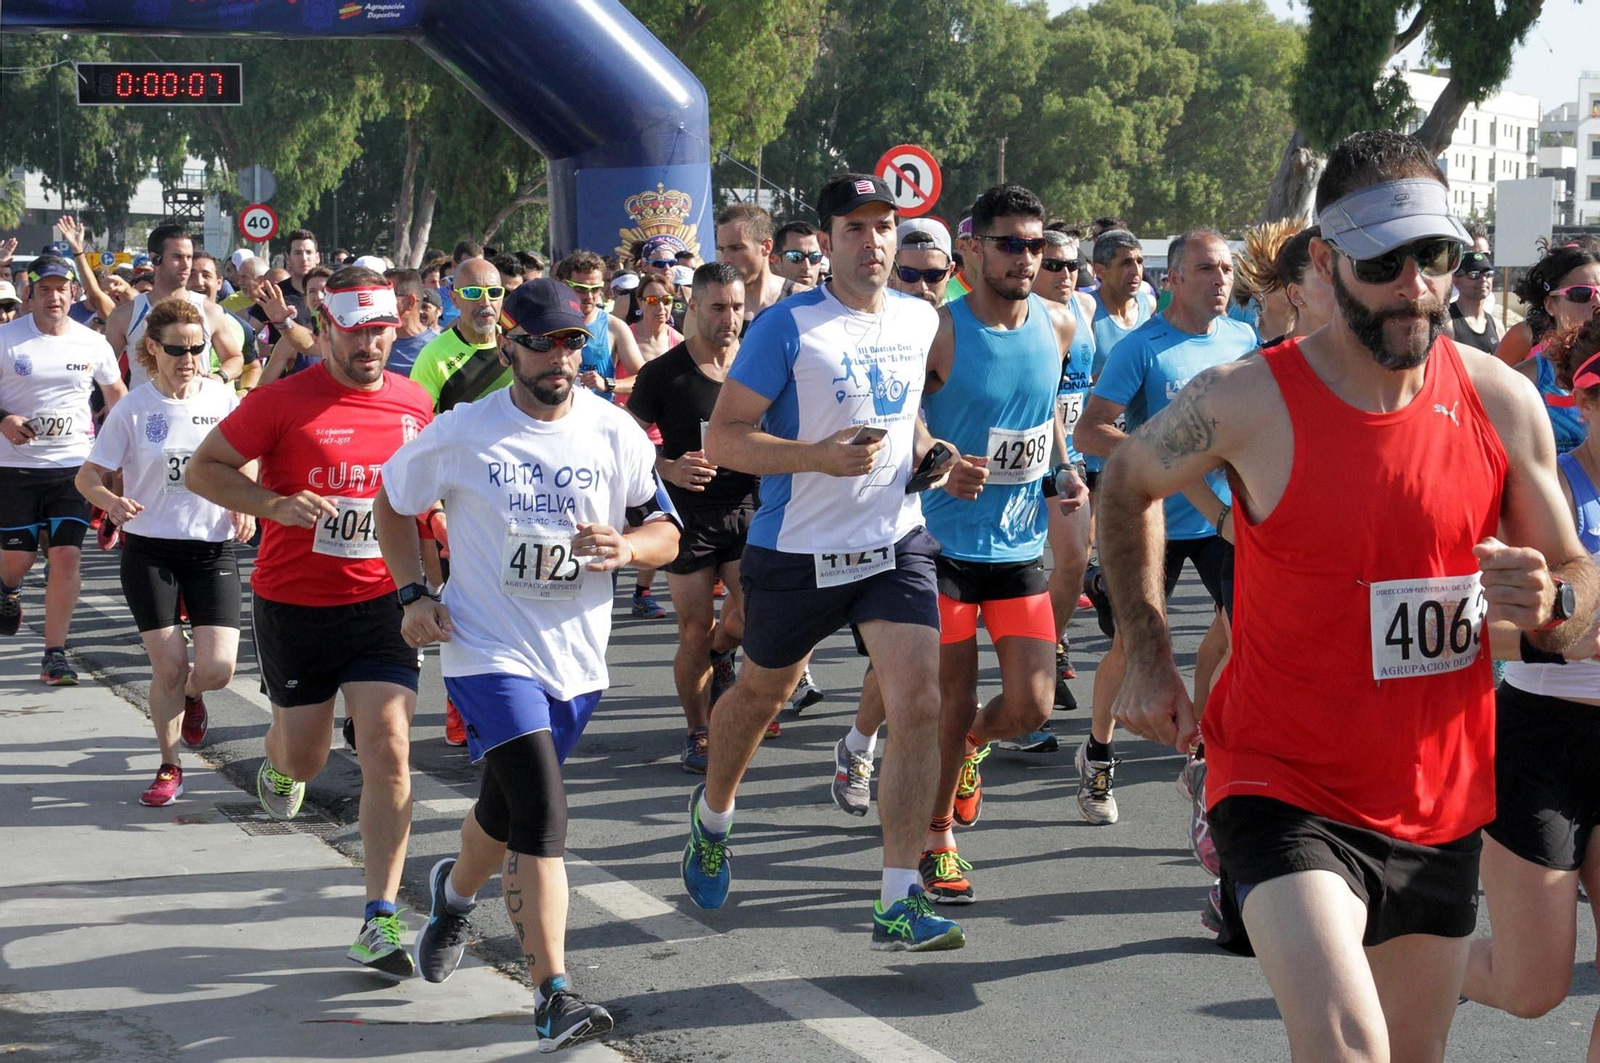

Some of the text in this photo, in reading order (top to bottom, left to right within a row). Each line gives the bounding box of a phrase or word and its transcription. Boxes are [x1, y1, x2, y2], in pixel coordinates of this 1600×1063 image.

[116, 72, 223, 97] 0:00:07
[247, 216, 270, 229] 40
[66, 363, 87, 371] CNP
[192, 416, 217, 425] CNP
[993, 434, 1047, 469] 4298
[488, 462, 600, 492] RUTA 091
[509, 493, 576, 514] HUELVA
[510, 542, 580, 581] 4125
[1376, 587, 1413, 596] DIRECCIÓN
[1415, 586, 1450, 594] GENERAL
[1380, 661, 1451, 676] AGRUPACIÓN
